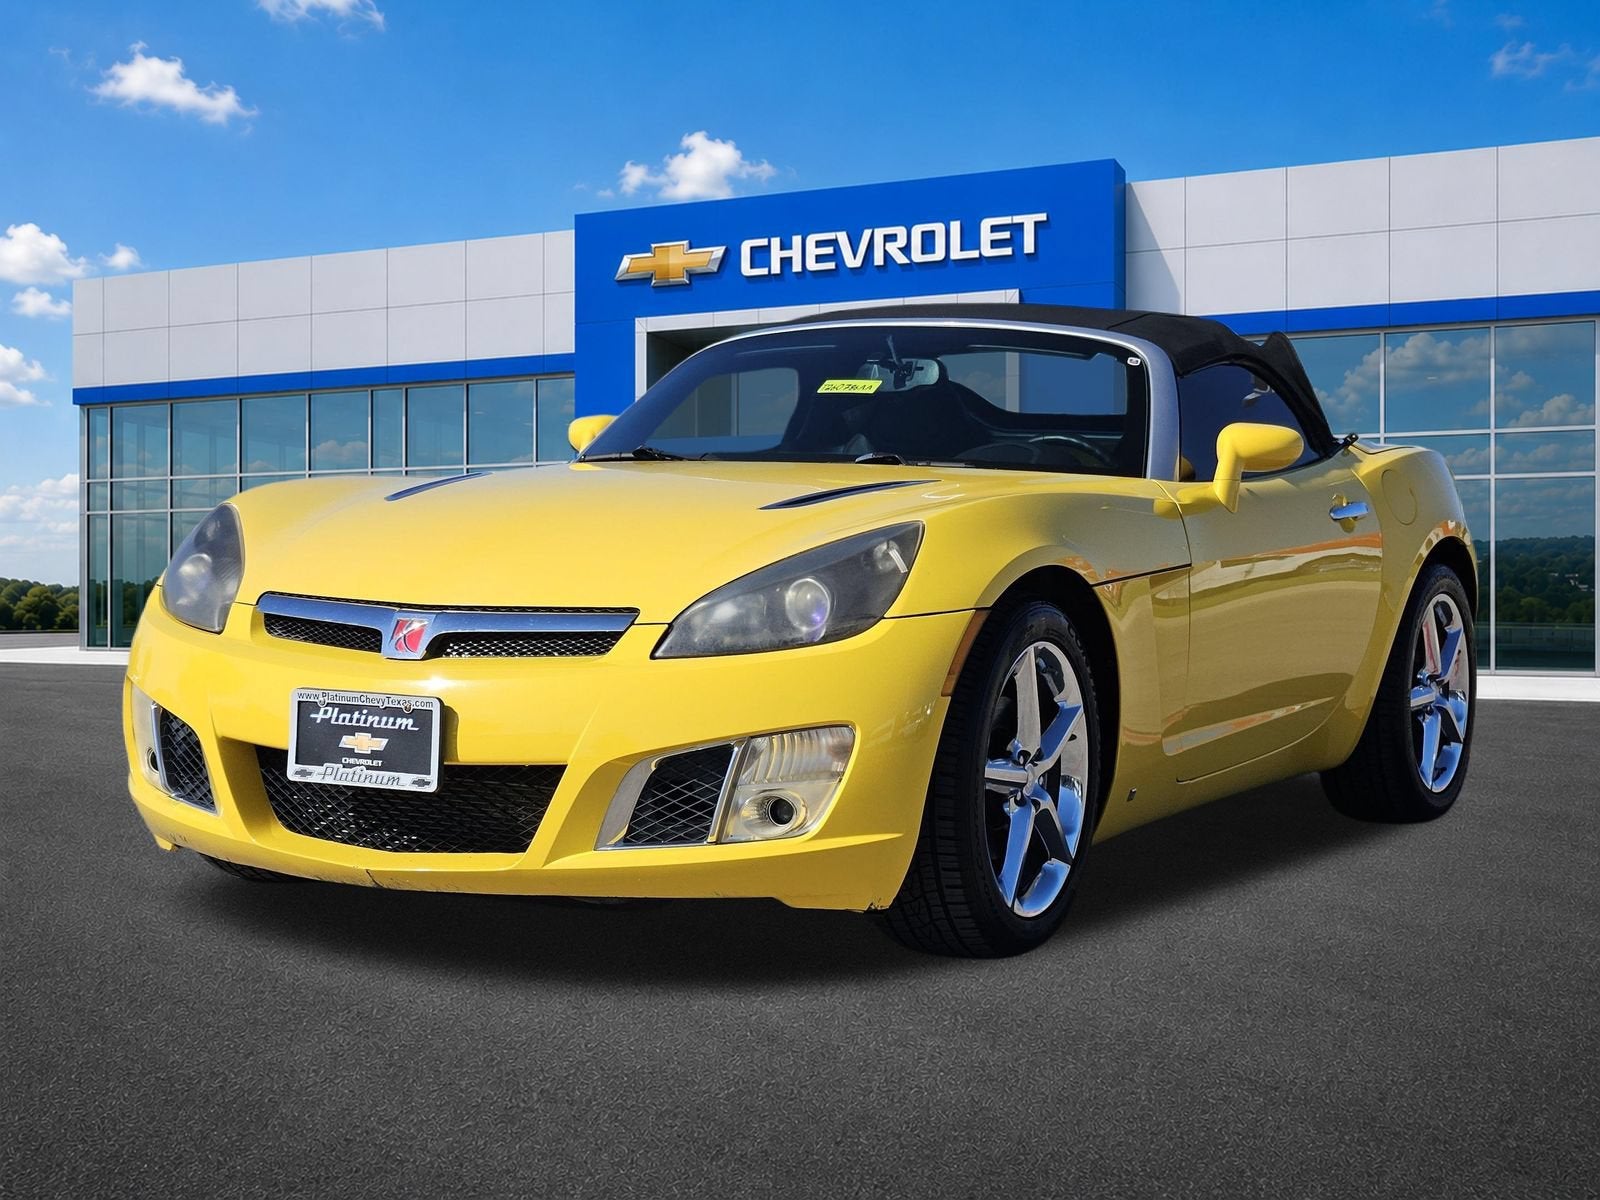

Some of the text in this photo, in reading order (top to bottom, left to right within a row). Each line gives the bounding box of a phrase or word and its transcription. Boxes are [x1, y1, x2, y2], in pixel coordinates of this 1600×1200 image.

[740, 213, 1048, 277] CHEVROLET
[309, 706, 420, 731] Platinum
[341, 757, 383, 767] CHEVROLET
[316, 766, 406, 787] Platinum
